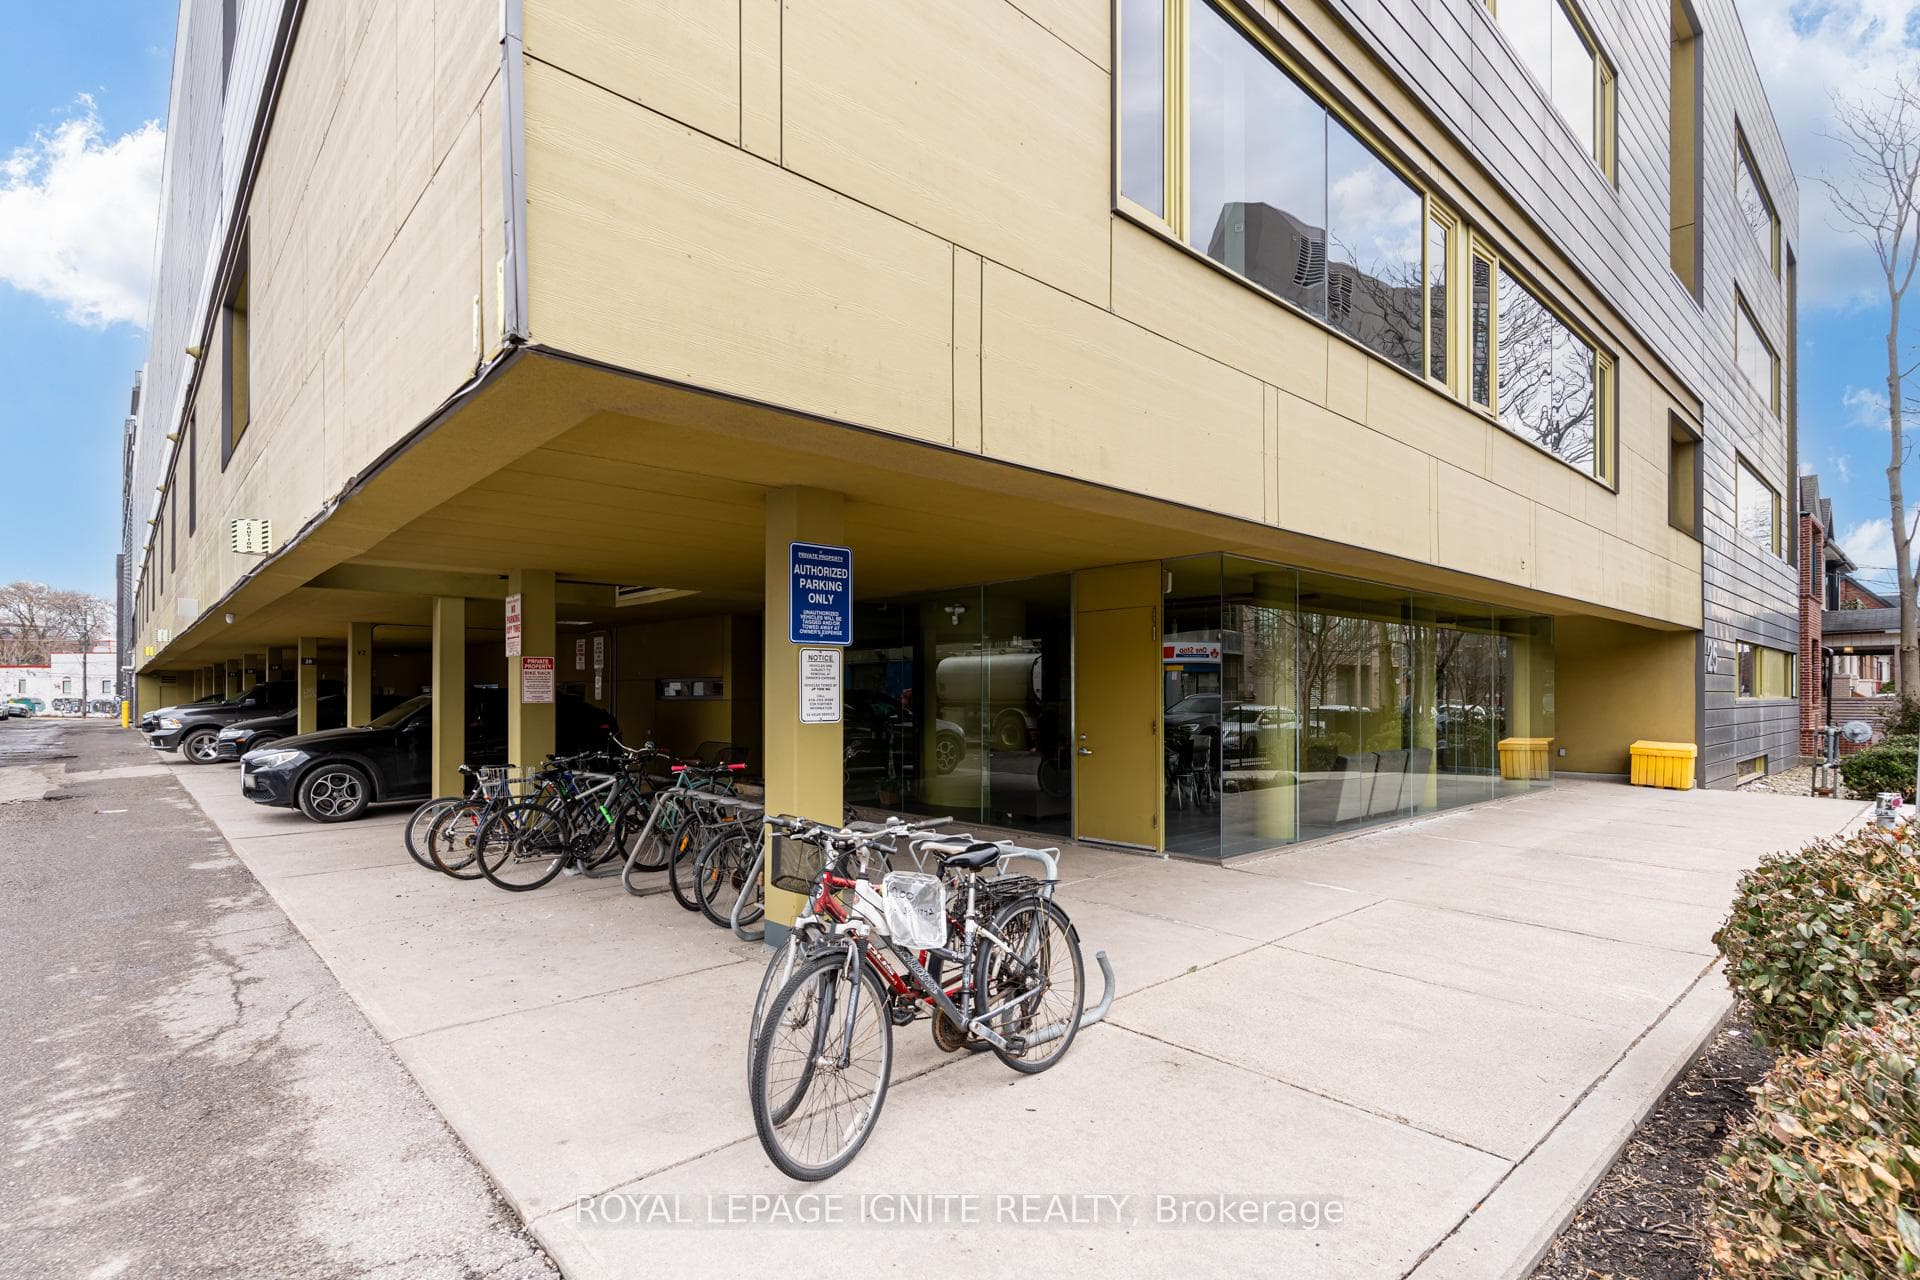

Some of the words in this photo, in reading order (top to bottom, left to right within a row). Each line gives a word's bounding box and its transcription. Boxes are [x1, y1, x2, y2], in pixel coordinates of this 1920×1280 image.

[798, 552, 818, 560] PRIVATE
[794, 563, 848, 579] AUTHORIZED
[799, 578, 843, 592] PARKING
[808, 593, 834, 605] ONLY
